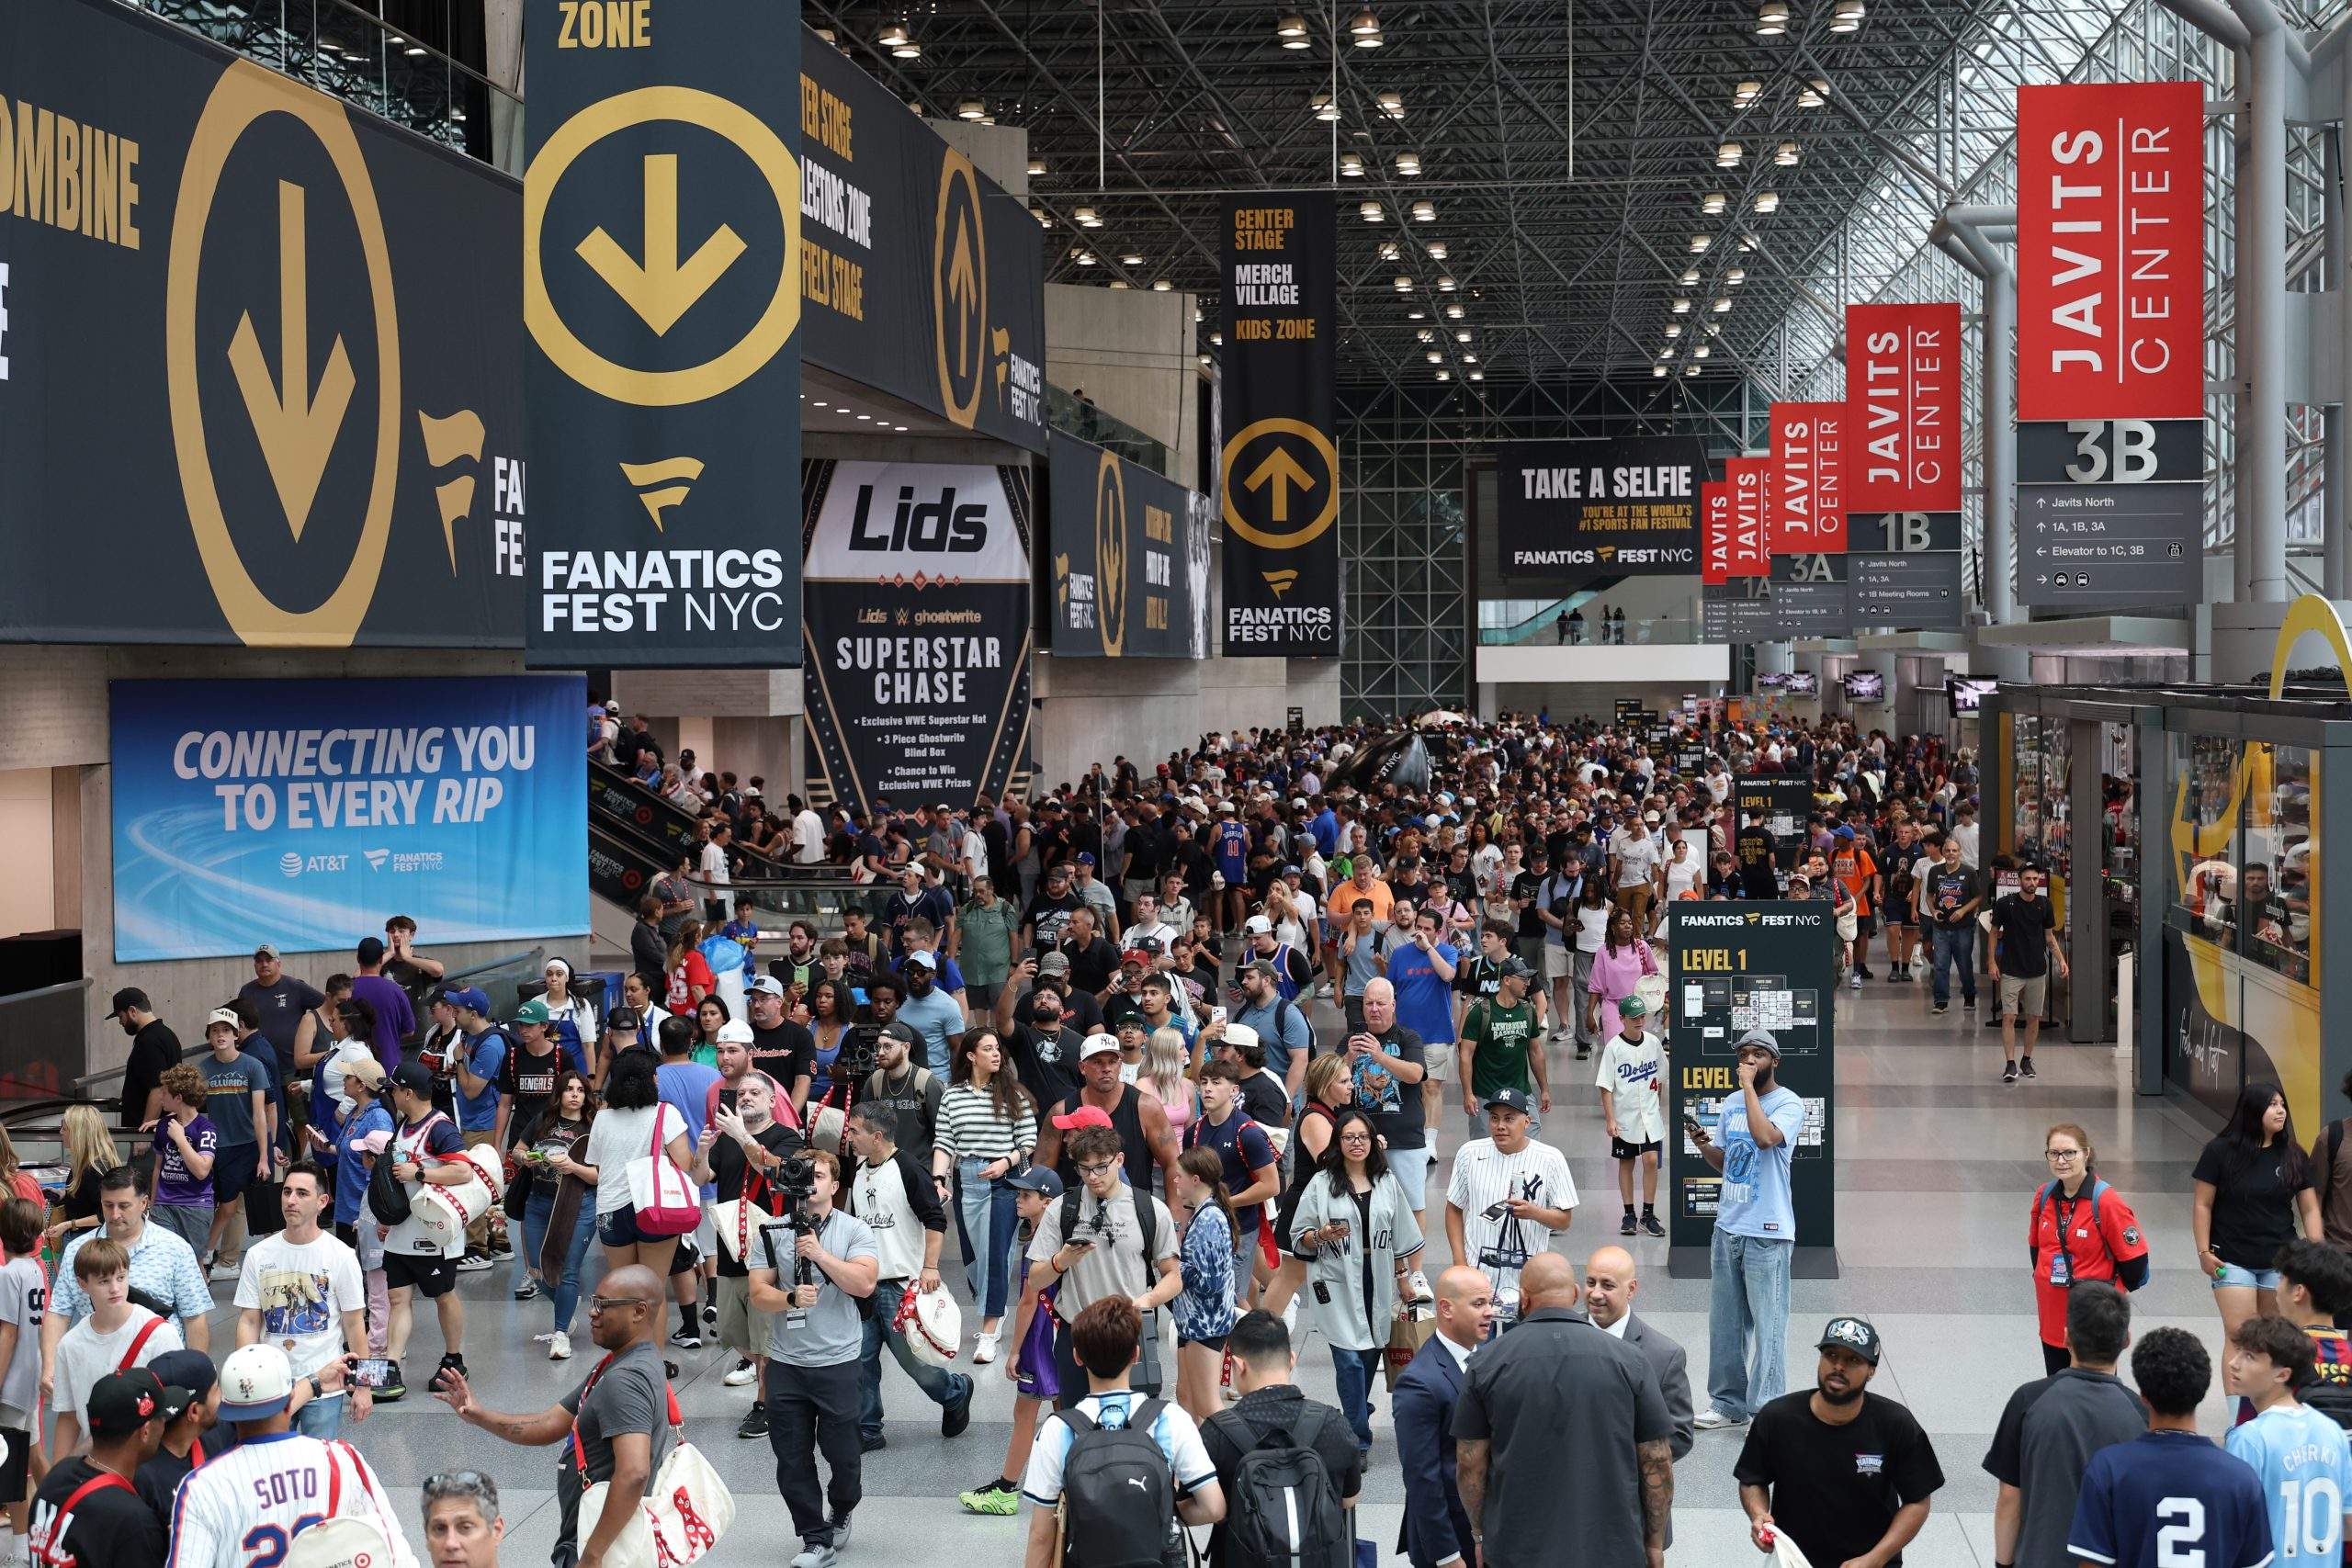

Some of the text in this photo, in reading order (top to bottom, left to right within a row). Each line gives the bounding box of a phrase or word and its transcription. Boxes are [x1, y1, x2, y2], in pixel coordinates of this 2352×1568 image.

[558, 0, 650, 49] ZONE
[821, 89, 853, 163] STAGE
[846, 183, 871, 250] ZONE
[1235, 209, 1294, 230] CENTER
[1235, 230, 1284, 251] STAGE
[2051, 125, 2171, 376] JAVITS CENTER
[1236, 264, 1293, 285] MERCH
[831, 254, 863, 321] STAGE
[1236, 284, 1299, 306] VILLAGE
[1236, 319, 1315, 340] KIDS ZONE
[1011, 353, 1040, 395] FANATICS
[1012, 386, 1042, 427] FEST NYC
[1867, 329, 1940, 485] JAVITS CENTER
[2064, 420, 2159, 483] 3B
[494, 456, 525, 514] FA
[1521, 465, 1692, 500] TAKE A SELFIE
[1784, 422, 1808, 533] JAVITS
[1820, 420, 1838, 533] CENTER
[1581, 503, 1692, 519] YOU'RE AT THE WORLD'S
[2052, 496, 2114, 508] Javits North
[848, 484, 988, 552] Lids
[1578, 516, 1692, 531] #1 SPORTS FAN FESTIVAL
[1737, 473, 1757, 560] JAVITS
[2052, 521, 2106, 533] 1A, 1B, 3A
[1712, 496, 1727, 570] JAVITS
[1878, 513, 1930, 551] 1B
[494, 519, 526, 576] FE
[1514, 548, 1693, 564] FANATICS FEST NYC
[2052, 545, 2144, 557] Elevator to 1C, 3B
[543, 549, 783, 591] FANATICS
[1790, 554, 1834, 582] 3A
[1868, 559, 1907, 568] Javits North
[1069, 572, 1094, 601] FANATICS
[1868, 575, 1890, 584] 1A, 3A
[1868, 590, 1929, 599] 1B Meeting Rooms
[543, 592, 784, 632] FEST NYC
[857, 608, 982, 626] Lids ghostwrite
[1069, 602, 1083, 629] FEST
[1229, 606, 1331, 625] FANATICS
[1229, 625, 1331, 642] FEST NYC
[836, 637, 1001, 670] SUPERSTAR
[874, 671, 966, 705] CHASE
[861, 714, 987, 727] Exclusive WWE Superstar Hat
[884, 732, 966, 744] 3 Piece Ghostwrite
[173, 725, 536, 781] CONNECTING YOU
[904, 747, 945, 758] Blind Box
[1679, 753, 1702, 761] TAILGATE
[895, 765, 956, 776] Chance to Win
[878, 779, 972, 791] Exclusive WWE Prizes
[215, 776, 503, 831] TO EVERY RIP
[1740, 795, 1771, 807] LEVEL 1
[393, 852, 443, 863] FANATICS
[1227, 840, 1239, 856] 11
[306, 854, 349, 872] AT&T
[393, 861, 443, 872] FEST NYC
[1681, 915, 1821, 926] FANATICS FEST NYC
[1682, 949, 1747, 972] LEVEL 1
[1493, 1028, 1528, 1039] BASEBALL
[519, 1077, 554, 1090] BENGALS
[1649, 1077, 1657, 1091] 4
[1682, 1066, 1736, 1089] LEVEL
[199, 1130, 217, 1150] 22
[1391, 1352, 1412, 1360] LEVI'S
[254, 1467, 318, 1511] SOTO
[2280, 1476, 2341, 1558] 10
[243, 1513, 326, 1568] 2
[2156, 1496, 2206, 1568] 2
